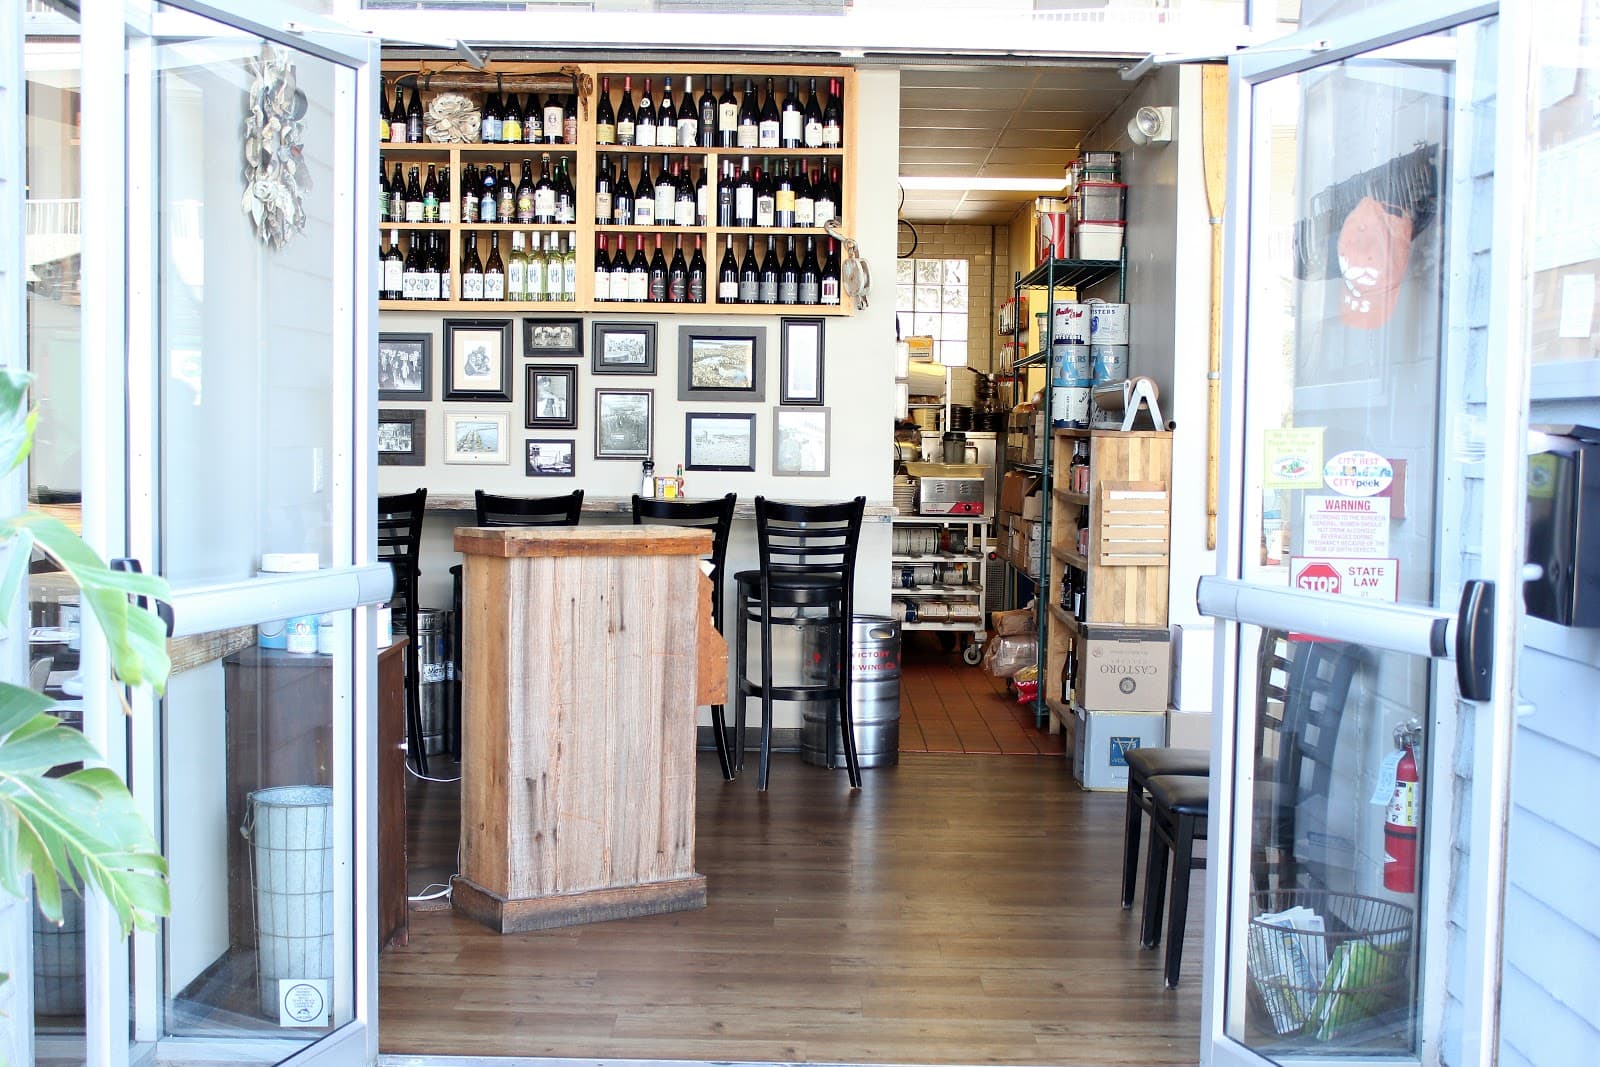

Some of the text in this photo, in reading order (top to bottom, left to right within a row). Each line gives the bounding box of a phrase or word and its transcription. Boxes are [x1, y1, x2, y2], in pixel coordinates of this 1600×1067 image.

[1324, 499, 1371, 511] WARNING
[1299, 567, 1385, 593] STOP STATE
[1353, 578, 1380, 587] LAW
[1099, 664, 1158, 675] CASTORO
